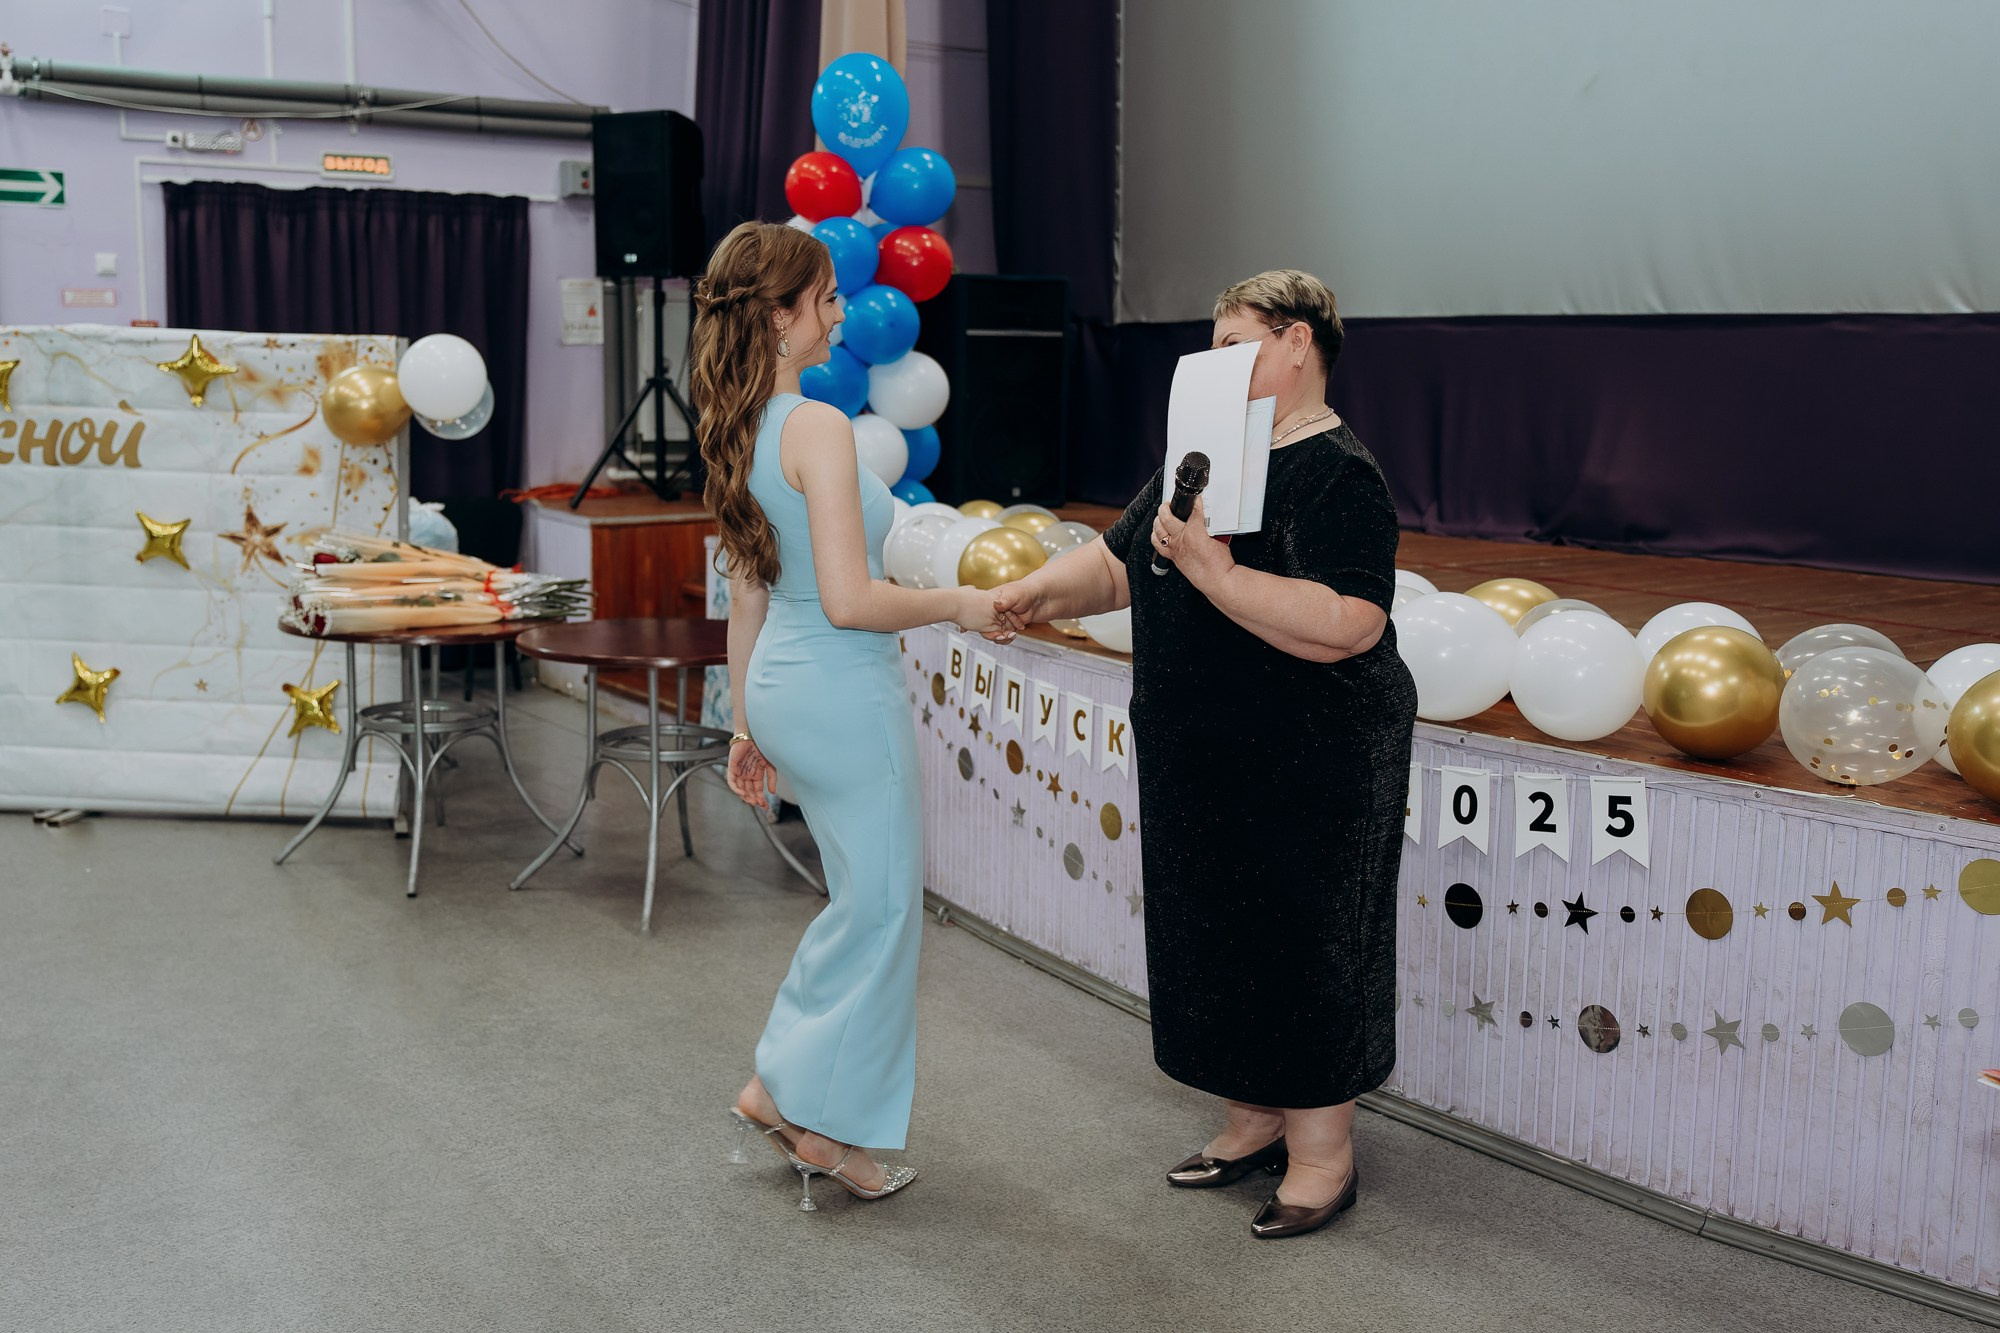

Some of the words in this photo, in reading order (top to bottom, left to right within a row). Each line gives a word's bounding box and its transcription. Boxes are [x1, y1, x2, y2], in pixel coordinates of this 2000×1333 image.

[324, 156, 389, 175] ВЫХОД
[951, 648, 1126, 757] ВЫПУСК
[1405, 784, 1635, 838] 025
